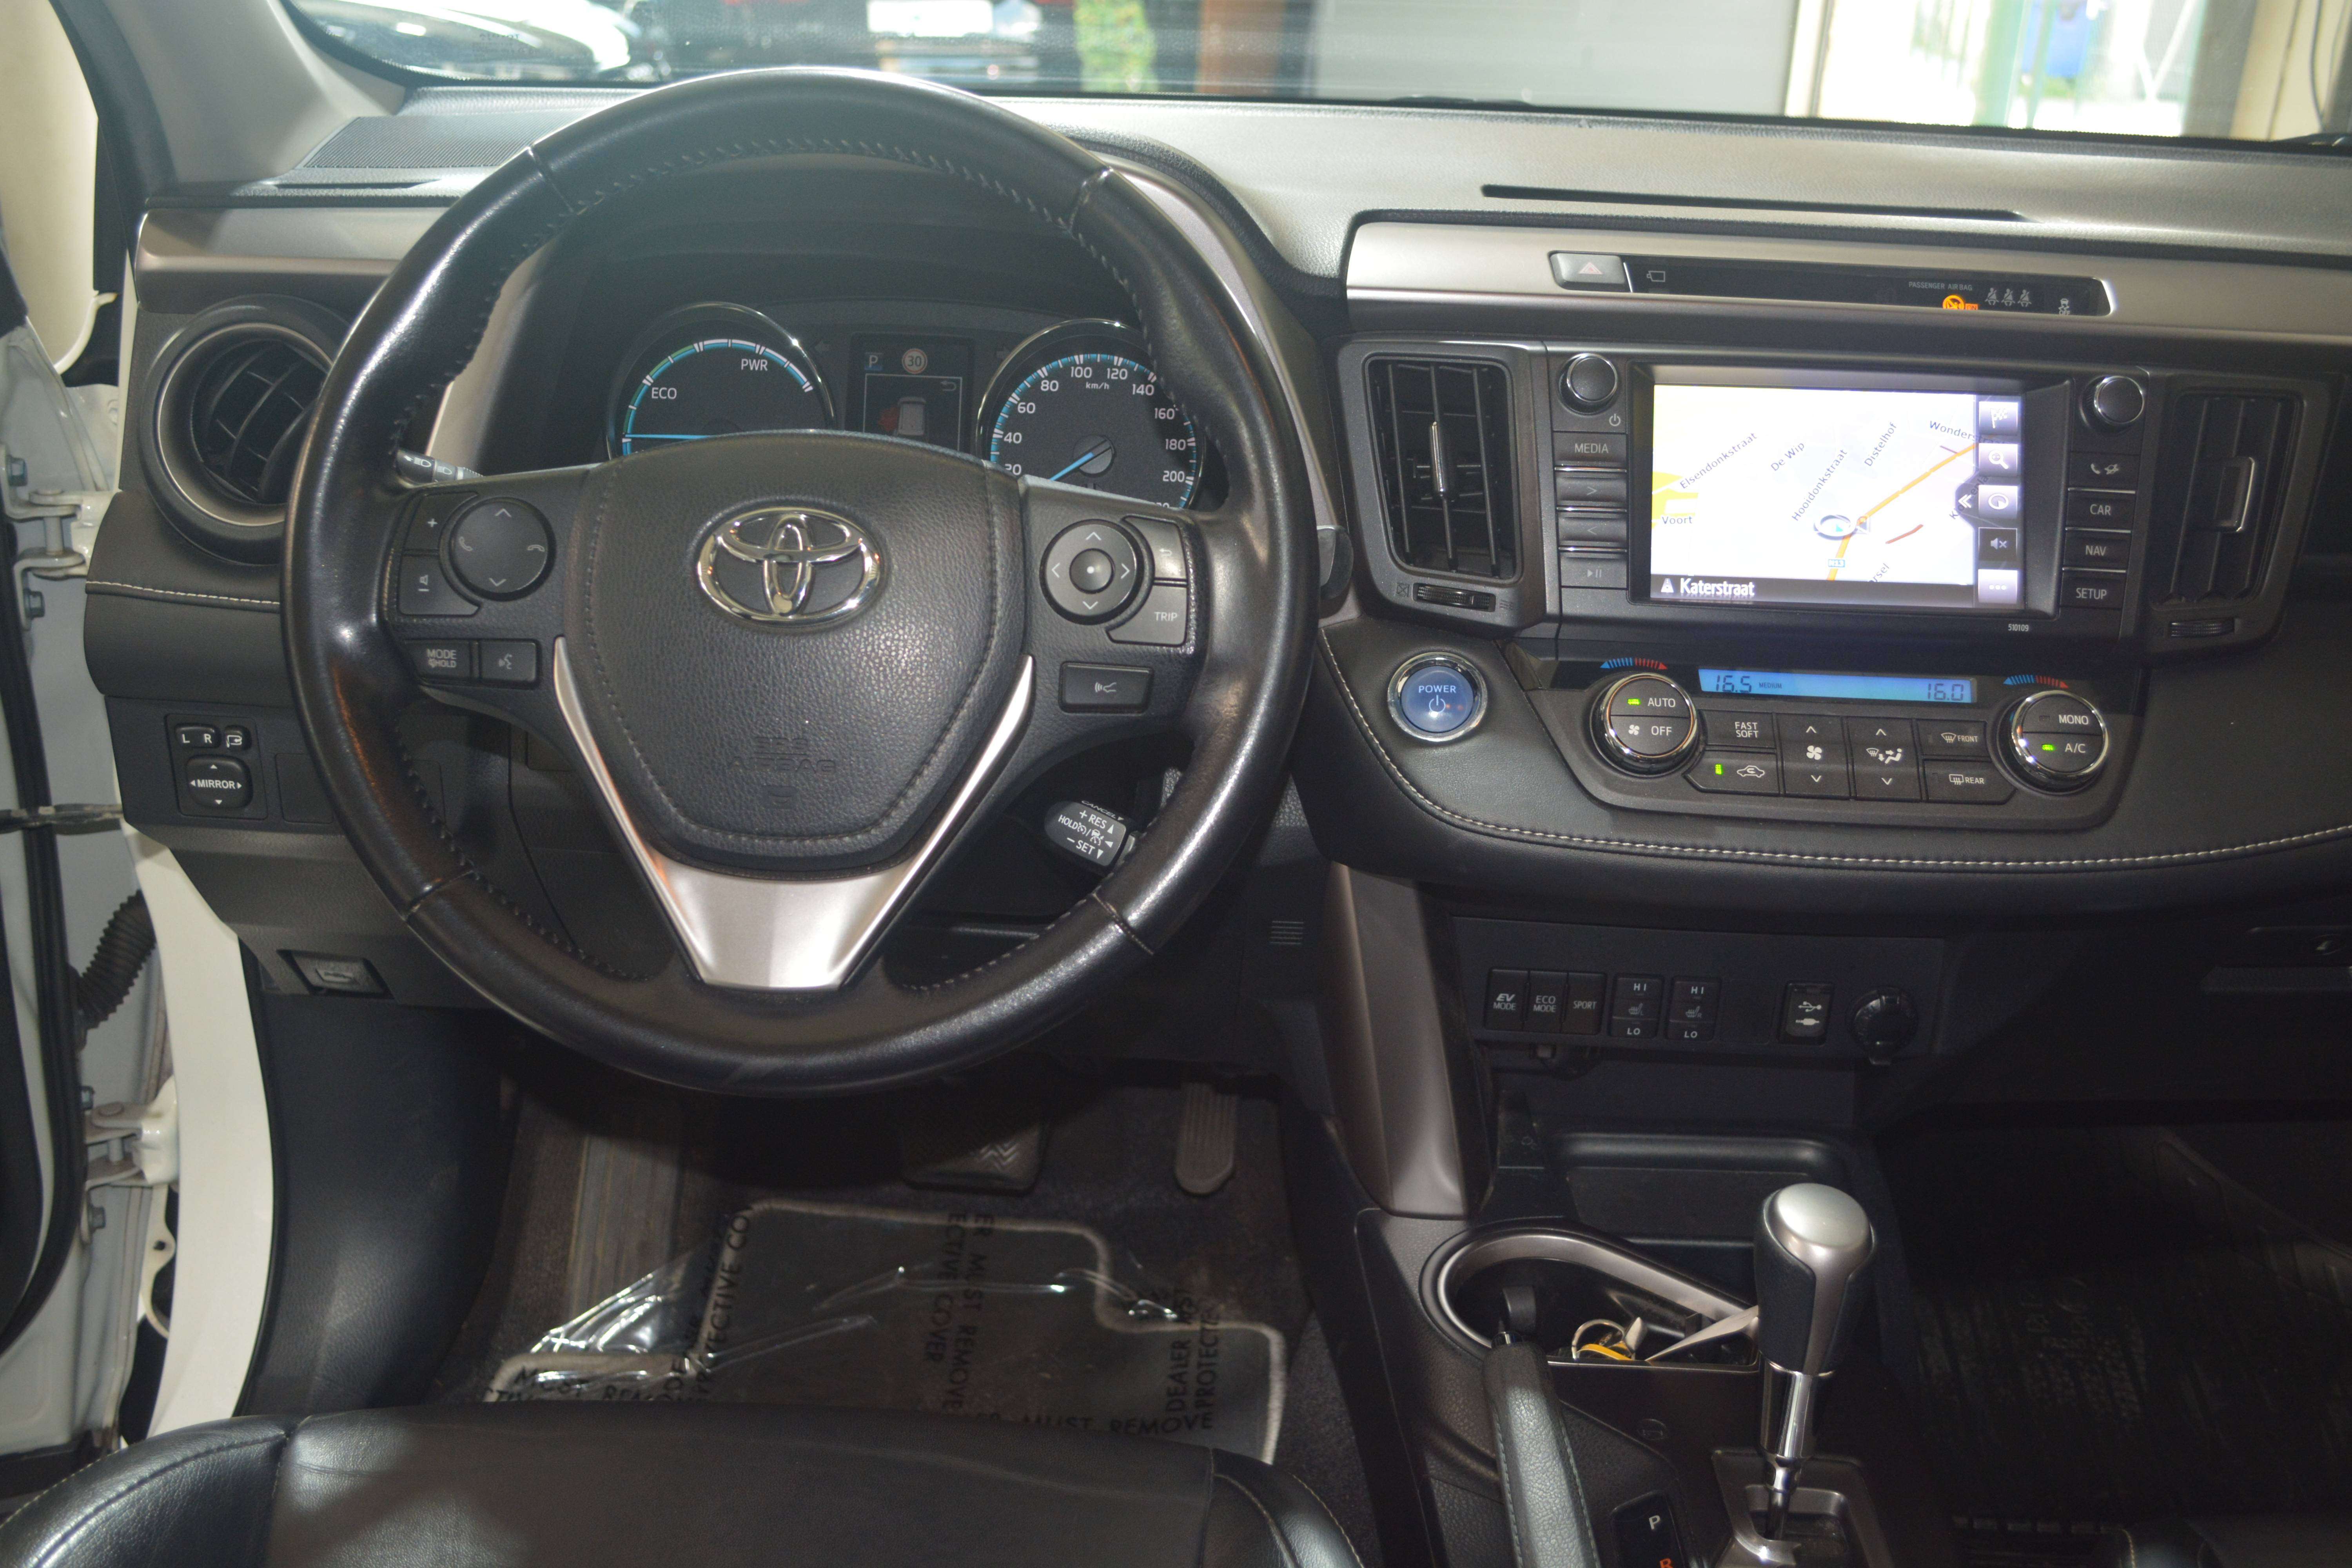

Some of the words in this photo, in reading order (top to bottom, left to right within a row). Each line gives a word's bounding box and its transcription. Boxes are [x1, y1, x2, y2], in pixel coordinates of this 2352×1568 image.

[1909, 281, 1945, 289] PASSENGER
[740, 358, 768, 371] PWR
[869, 355, 878, 367] P
[907, 356, 922, 367] 30
[1070, 366, 1092, 378] 100
[1107, 368, 1128, 380] 120
[1040, 380, 1059, 392] 80
[1132, 383, 1154, 396] 140
[651, 387, 677, 399] ECO
[1017, 402, 1036, 414] 60
[1154, 407, 1175, 420] 160
[1004, 432, 1022, 444] 40
[1165, 438, 1186, 450] 180
[1574, 443, 1609, 454] MEDIA
[1864, 421, 1898, 467] Distelhof
[1679, 432, 1758, 489] Elsendonkstraat
[1770, 458, 1786, 472] De
[1784, 442, 1805, 459] Wip
[1162, 470, 1185, 483] 200
[1791, 448, 1848, 521] Hooidonkstraat
[2090, 504, 2111, 515] CAR
[1662, 516, 1693, 524] Voort
[2085, 545, 2106, 556] NAV
[1680, 577, 1755, 596] Katerstraat
[2076, 588, 2107, 599] SETUP
[1154, 612, 1178, 621] TRIP
[2008, 623, 2029, 632] 510109
[426, 649, 457, 659] MODE
[1715, 675, 1752, 694] 16.5
[1927, 683, 1964, 701] 16.0
[1648, 697, 1676, 707] AUTO
[2058, 714, 2089, 725] MONO
[1651, 726, 1672, 736] OFF
[1735, 721, 1758, 730] FAST
[182, 734, 190, 743] L
[204, 733, 212, 744] R
[1736, 730, 1759, 738] SOFT
[2065, 743, 2086, 753] A/C
[197, 779, 235, 789] MIRROR
[1081, 800, 1116, 818] CANCEL
[1058, 815, 1078, 829] HOLD
[1633, 983, 1647, 991] HI
[1496, 993, 1516, 1002] EV
[1535, 995, 1556, 1004] ECO
[1493, 1002, 1516, 1011] MODE
[1533, 1004, 1557, 1013] MODE
[1573, 1000, 1597, 1010] SPORT
[924, 1293, 954, 1363] COVER
[1166, 1340, 1191, 1412] DEALER
[1109, 1412, 1213, 1435] REMOVE
[1648, 1515, 1661, 1530] P
[1659, 1558, 1674, 1568] R
